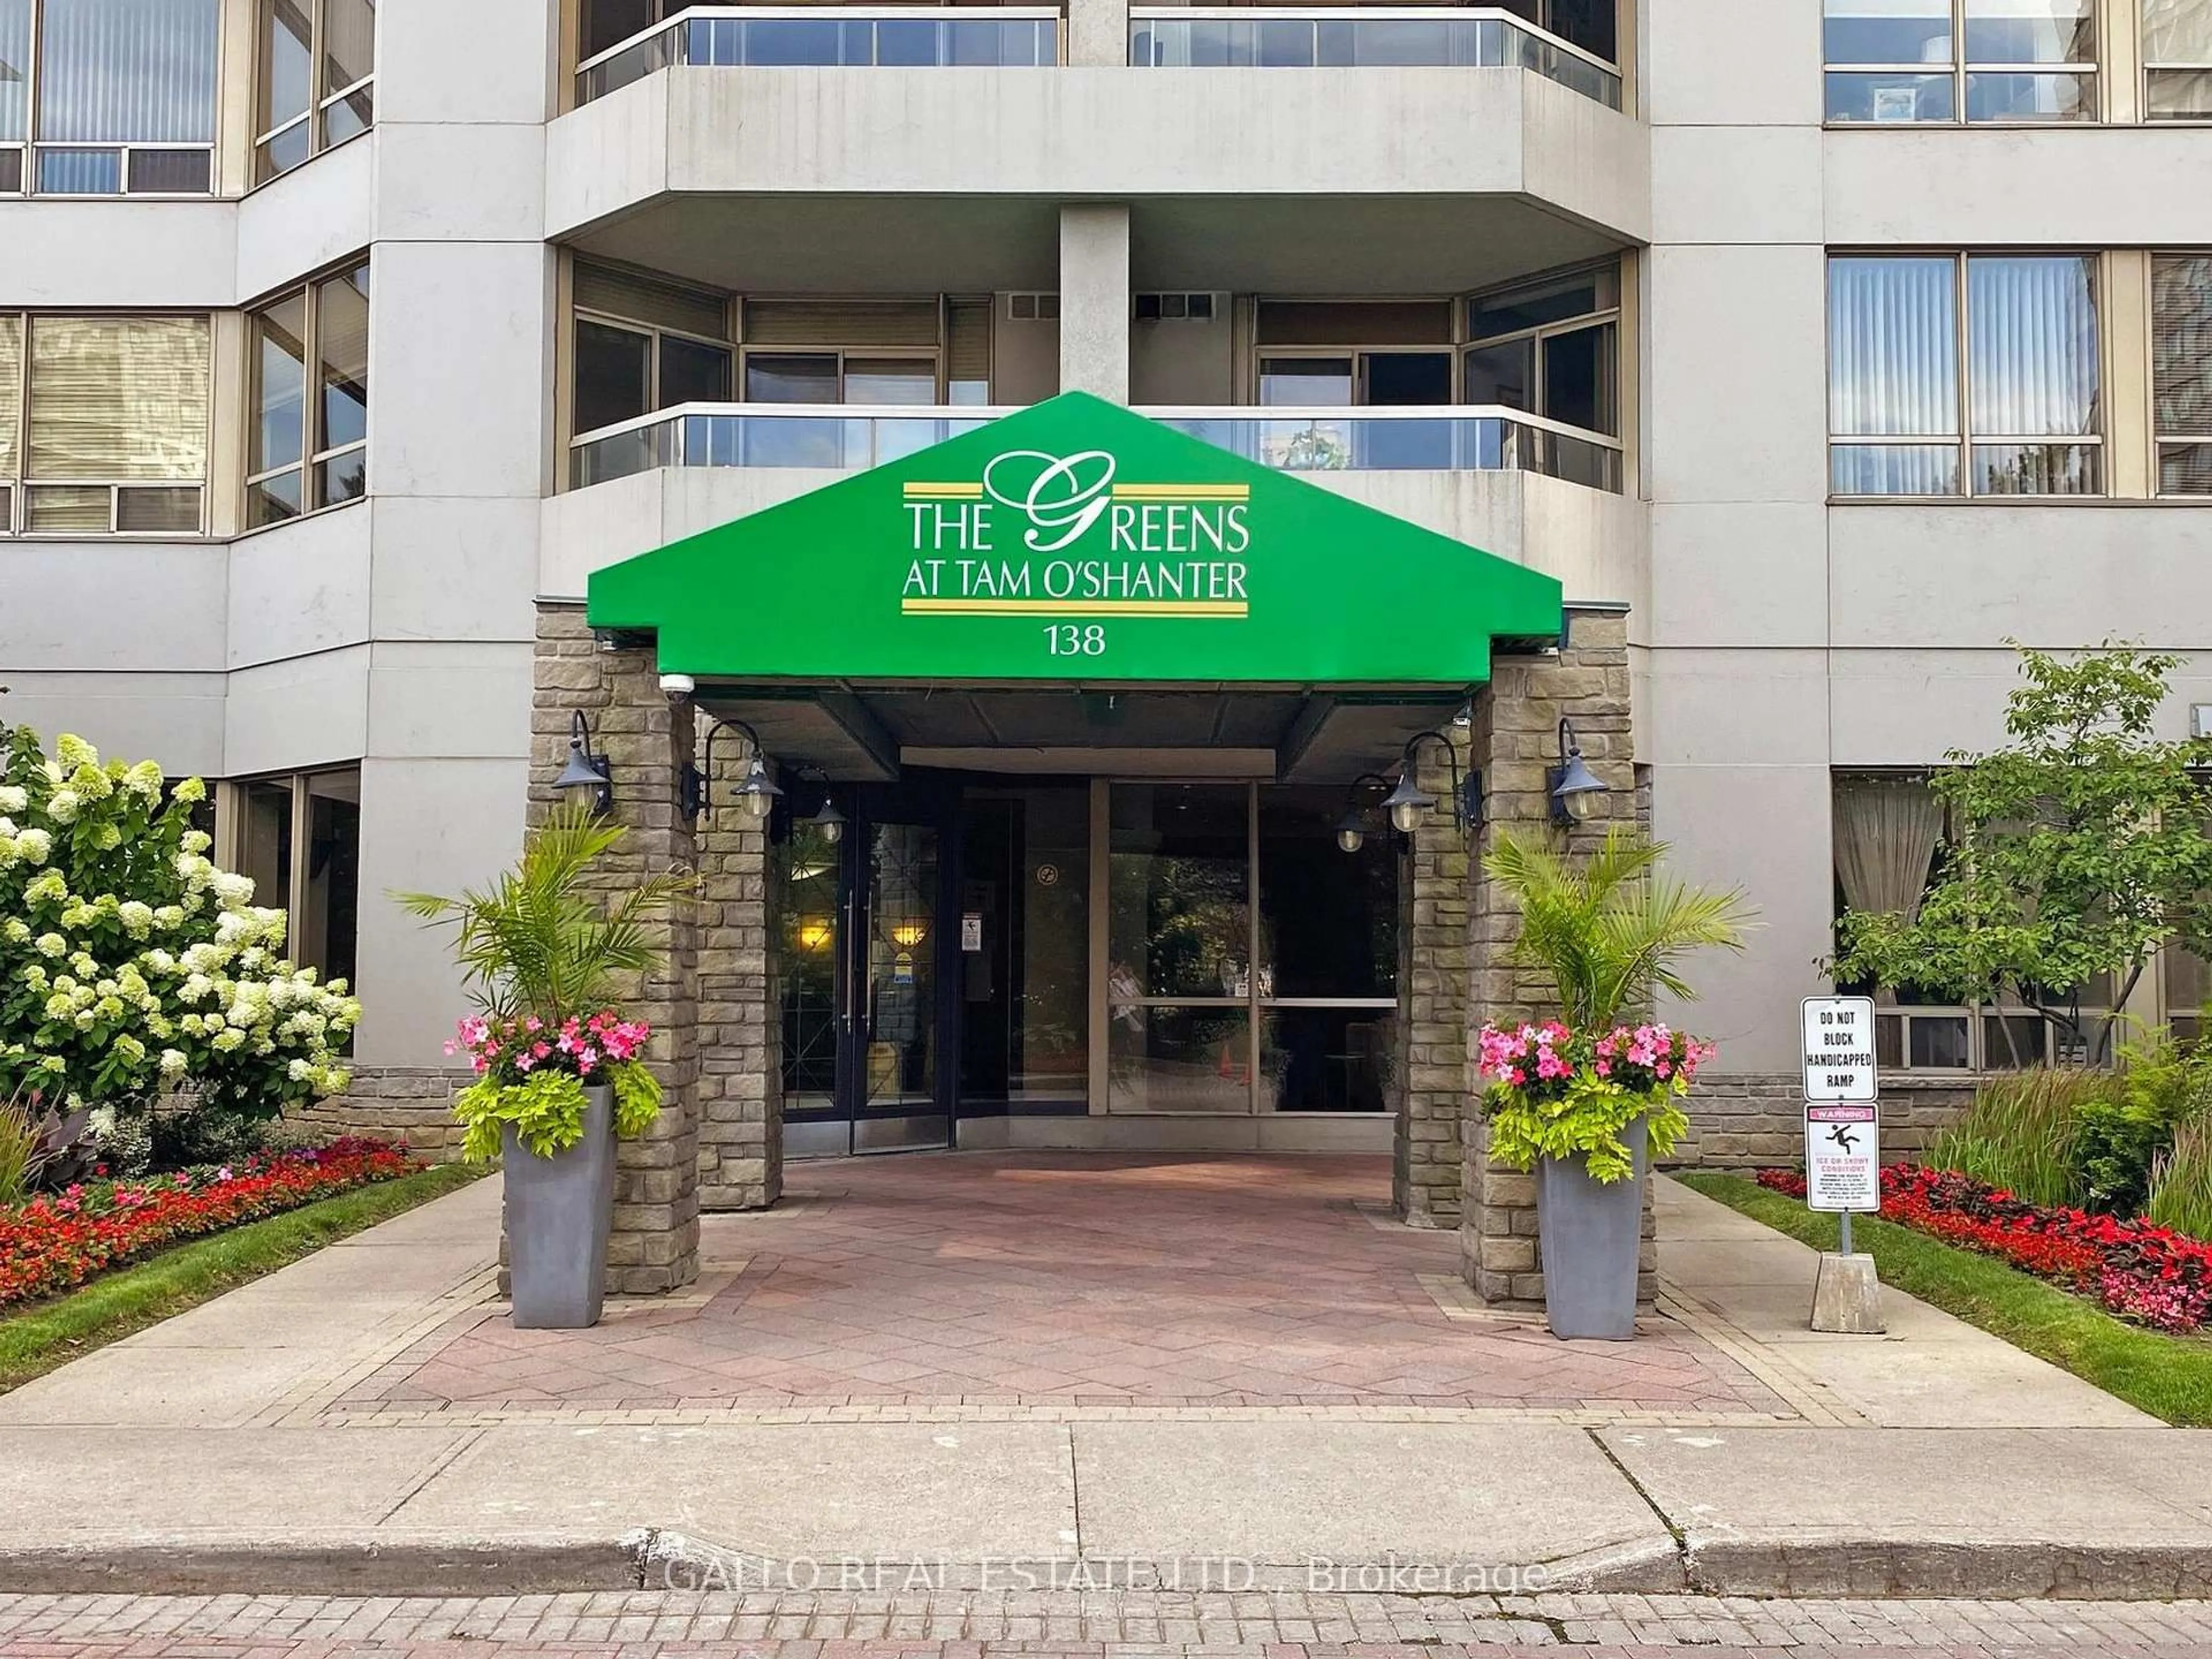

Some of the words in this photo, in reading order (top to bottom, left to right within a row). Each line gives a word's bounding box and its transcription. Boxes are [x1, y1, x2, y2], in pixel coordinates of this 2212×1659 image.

[903, 503, 993, 551] THE
[983, 449, 1250, 553] GREENS
[902, 559, 946, 595] AT
[955, 560, 1031, 596] TAM
[1043, 560, 1248, 599] O'SHANTER
[1043, 624, 1106, 656] 138
[1820, 1012, 1832, 1024] DO
[1837, 1012, 1855, 1024] NOT
[1824, 1033, 1853, 1046] BLOCK
[1807, 1054, 1872, 1066] HANDICAPPED
[1827, 1075, 1854, 1088] RAMP
[1818, 1110, 1866, 1119] WARNING
